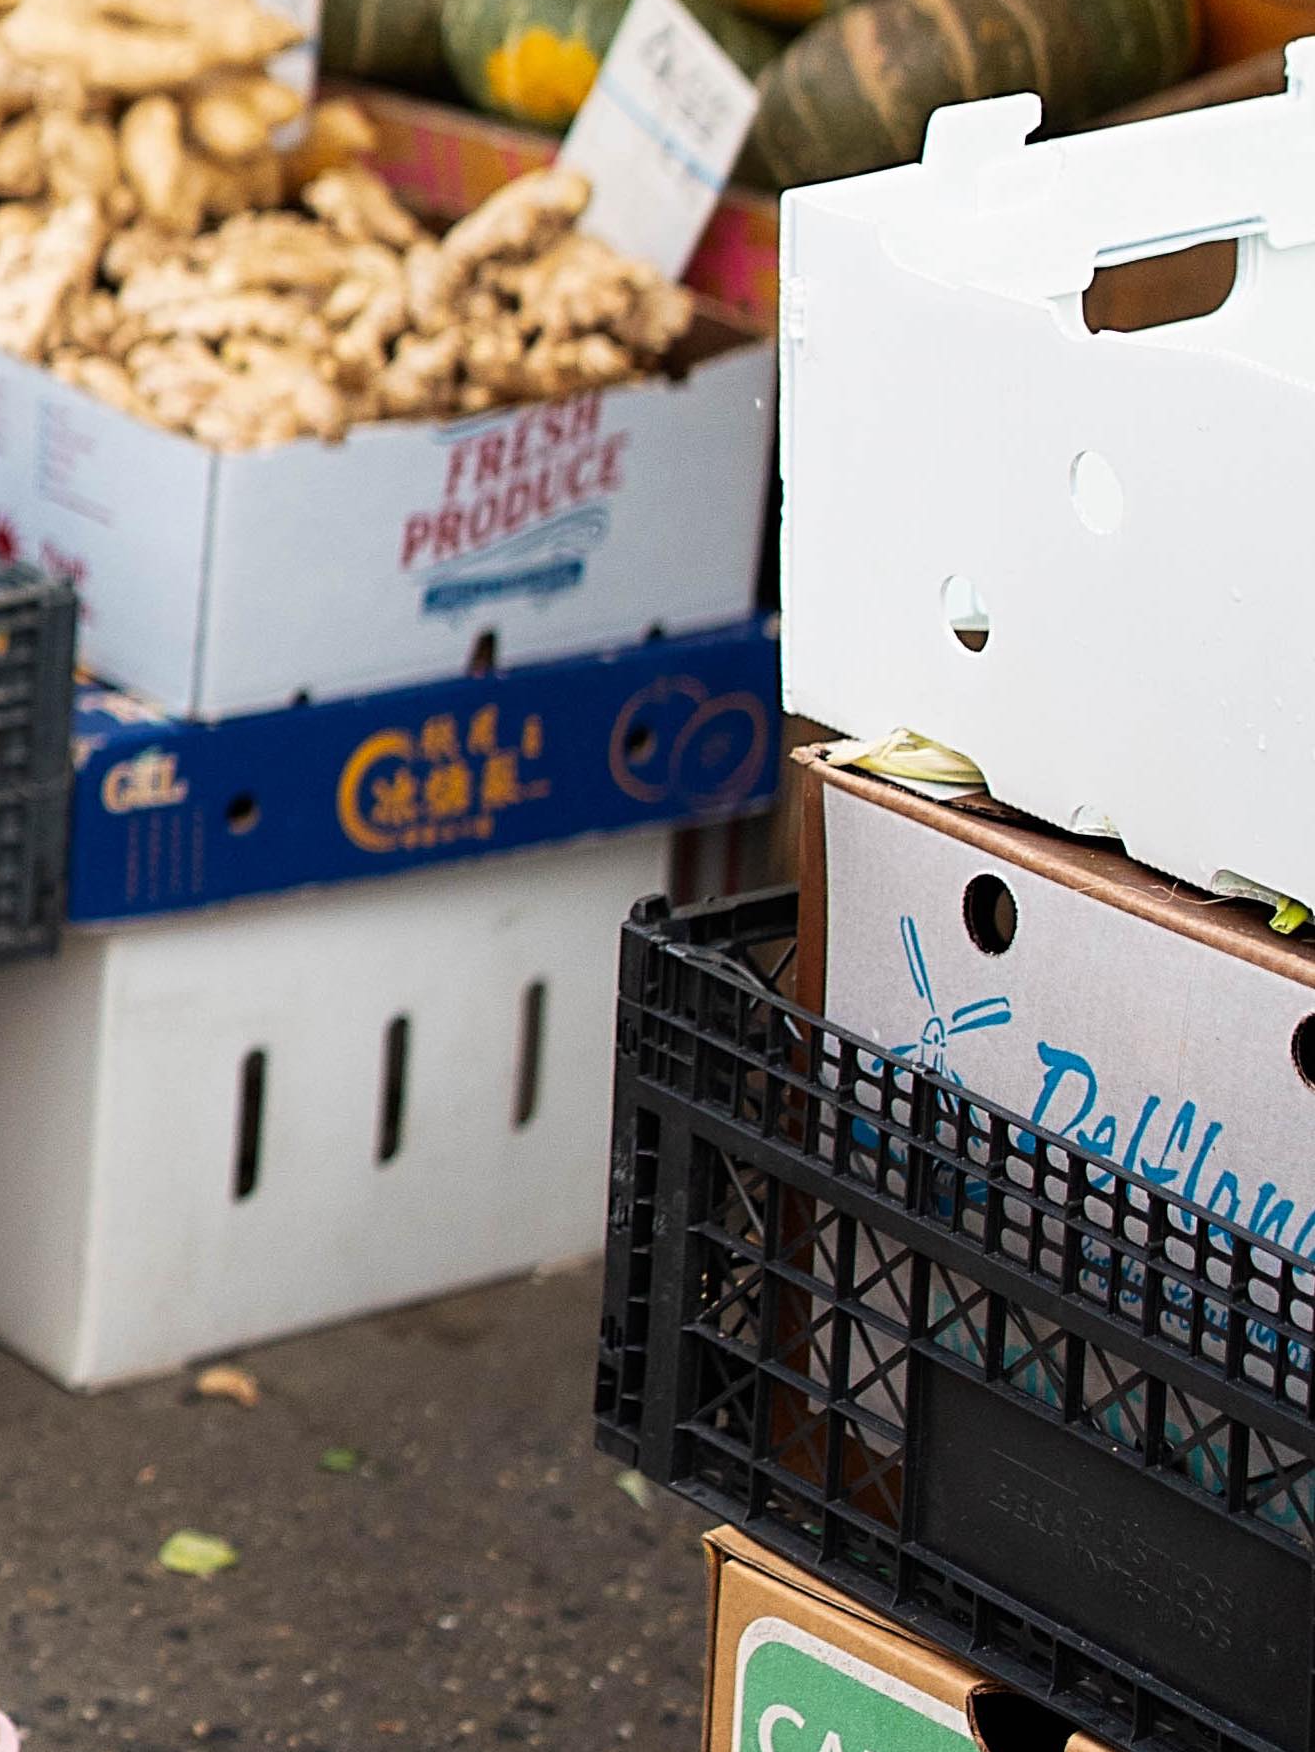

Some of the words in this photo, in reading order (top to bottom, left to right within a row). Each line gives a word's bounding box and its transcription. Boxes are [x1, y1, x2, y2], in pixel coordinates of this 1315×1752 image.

[398, 429, 631, 571] PRODUCE
[441, 386, 605, 504] FRESH
[1016, 1039, 1315, 1281] Delflan
